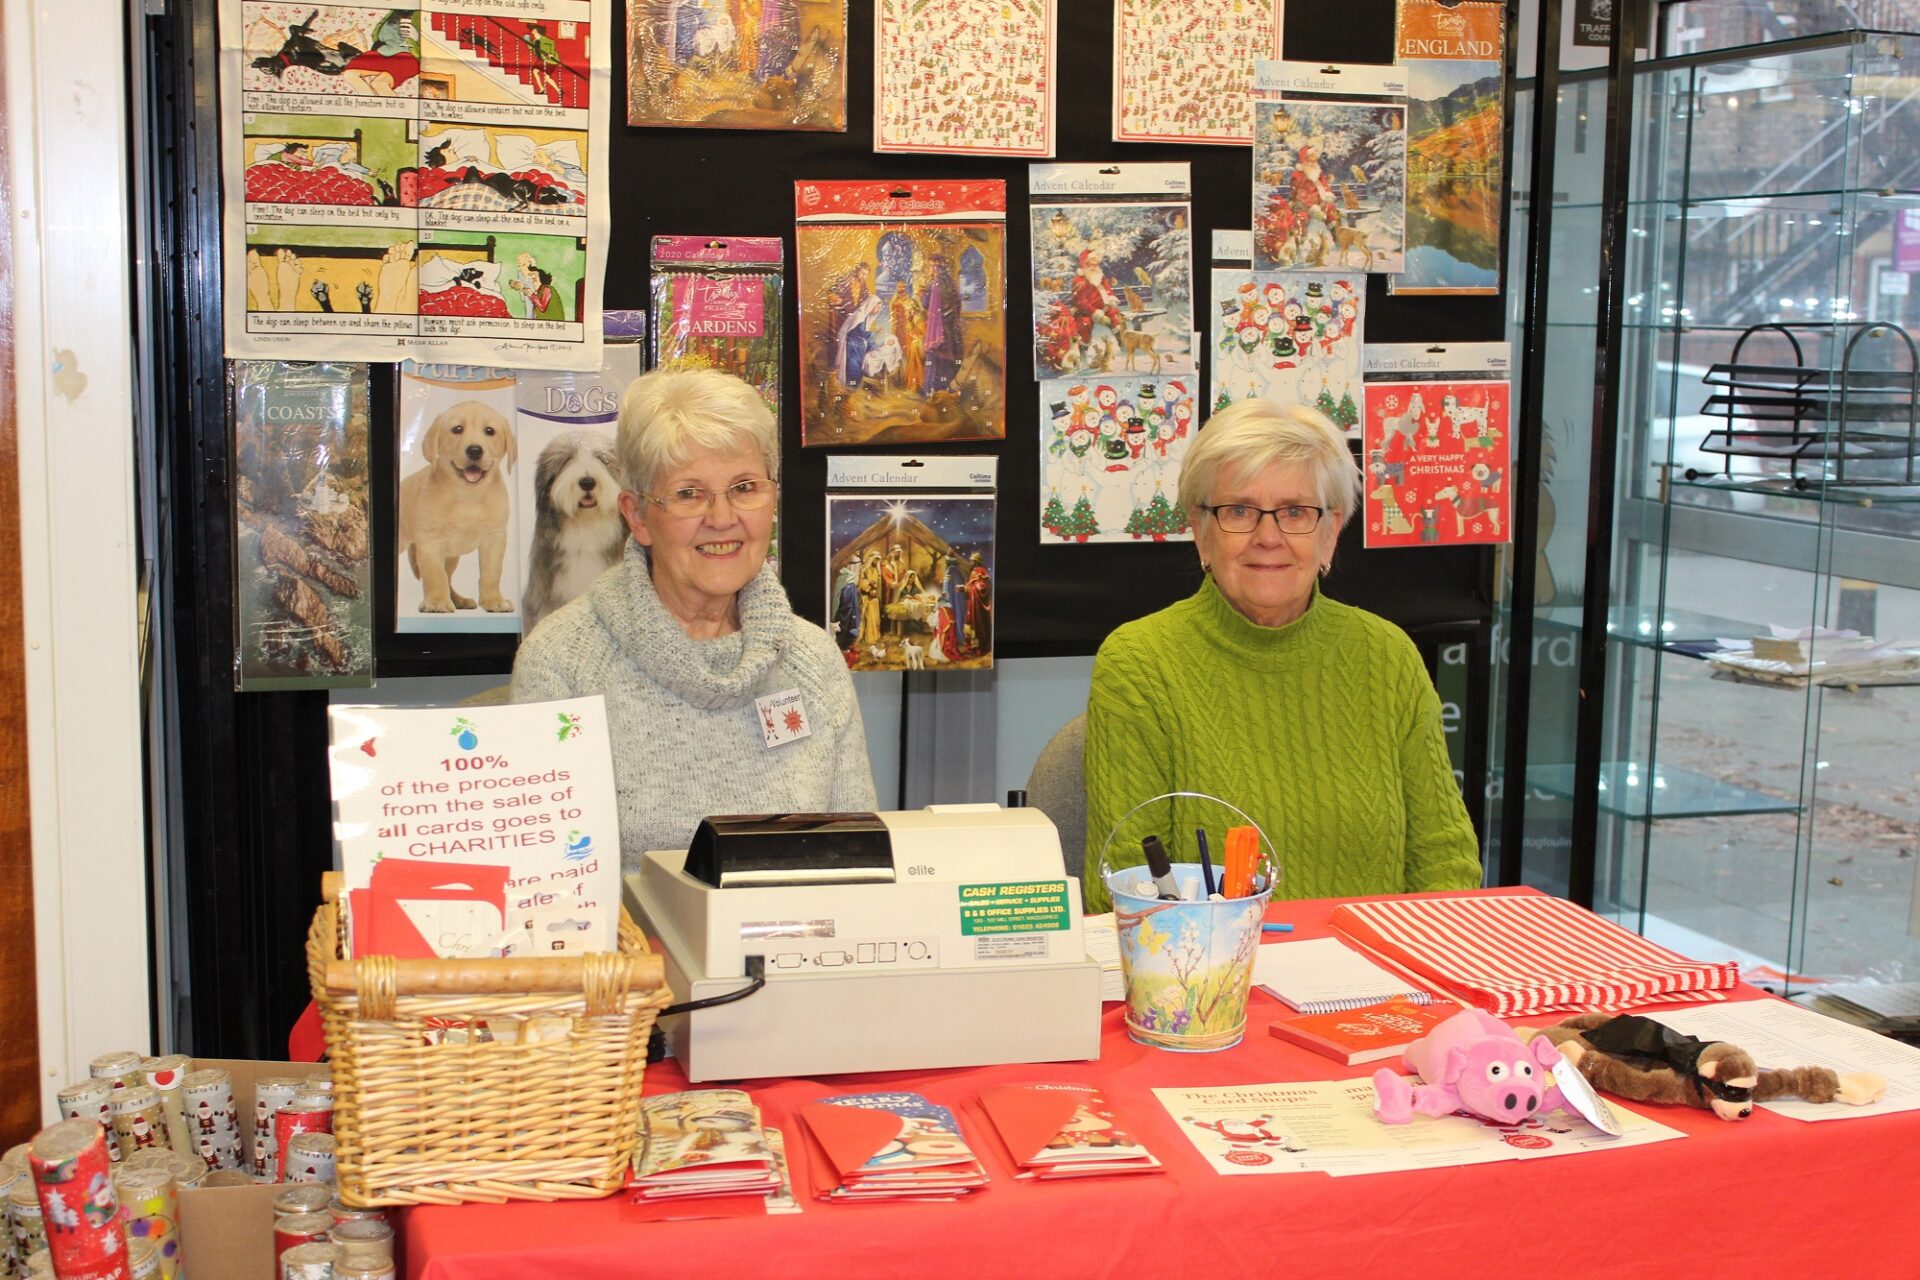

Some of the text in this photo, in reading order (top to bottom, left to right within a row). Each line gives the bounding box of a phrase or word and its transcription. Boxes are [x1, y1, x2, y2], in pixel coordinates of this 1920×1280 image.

[1580, 23, 1610, 33] TRAFF
[1405, 39, 1493, 56] ENGLAND
[1258, 77, 1336, 90] Advent Calendar
[279, 96, 291, 107] dog
[300, 96, 323, 105] allowed
[261, 104, 284, 112] allowed
[446, 102, 457, 114] dog
[464, 104, 486, 113] allowed
[512, 107, 523, 115] but
[544, 107, 554, 116] the
[1033, 179, 1116, 191] Advent Calendar
[898, 199, 945, 210] Calendar
[270, 205, 283, 214] The
[284, 206, 295, 217] dog
[309, 207, 325, 217] sleep
[336, 207, 347, 217] the
[348, 208, 360, 217] bed
[362, 208, 373, 218] but
[375, 209, 390, 221] only
[438, 211, 450, 221] The
[450, 212, 462, 224] dog
[475, 214, 491, 224] sleep
[501, 213, 512, 223] the
[513, 215, 525, 223] end
[534, 215, 544, 224] the
[545, 216, 556, 225] bed
[659, 251, 682, 259] 2020
[1216, 246, 1249, 257] Advent
[252, 315, 264, 325] The
[266, 315, 278, 328] dog
[293, 317, 309, 328] sleep
[311, 316, 338, 327] between
[348, 317, 362, 328] and
[382, 319, 392, 328] the
[521, 321, 535, 331] sleep
[545, 322, 554, 330] the
[1366, 357, 1442, 369] Advent Calendar
[267, 406, 346, 421] COASTS
[1438, 454, 1465, 462] HAPPY
[1409, 465, 1465, 475] CHRISTMAS
[831, 472, 919, 484] Advent Calendar
[440, 754, 510, 773] 100%
[381, 769, 571, 796] of the proceeds
[382, 786, 574, 818] from the sale of
[377, 807, 582, 839] all cards goes to
[408, 829, 556, 858] CHARITIES
[907, 864, 936, 877] elite
[963, 883, 1065, 898] CASH REGISTERS
[987, 908, 1012, 916] OFFICE
[1014, 906, 1049, 915] SUPPLIES
[1181, 1089, 1318, 1100] The Christmas
[1251, 1096, 1310, 1105] Shops
